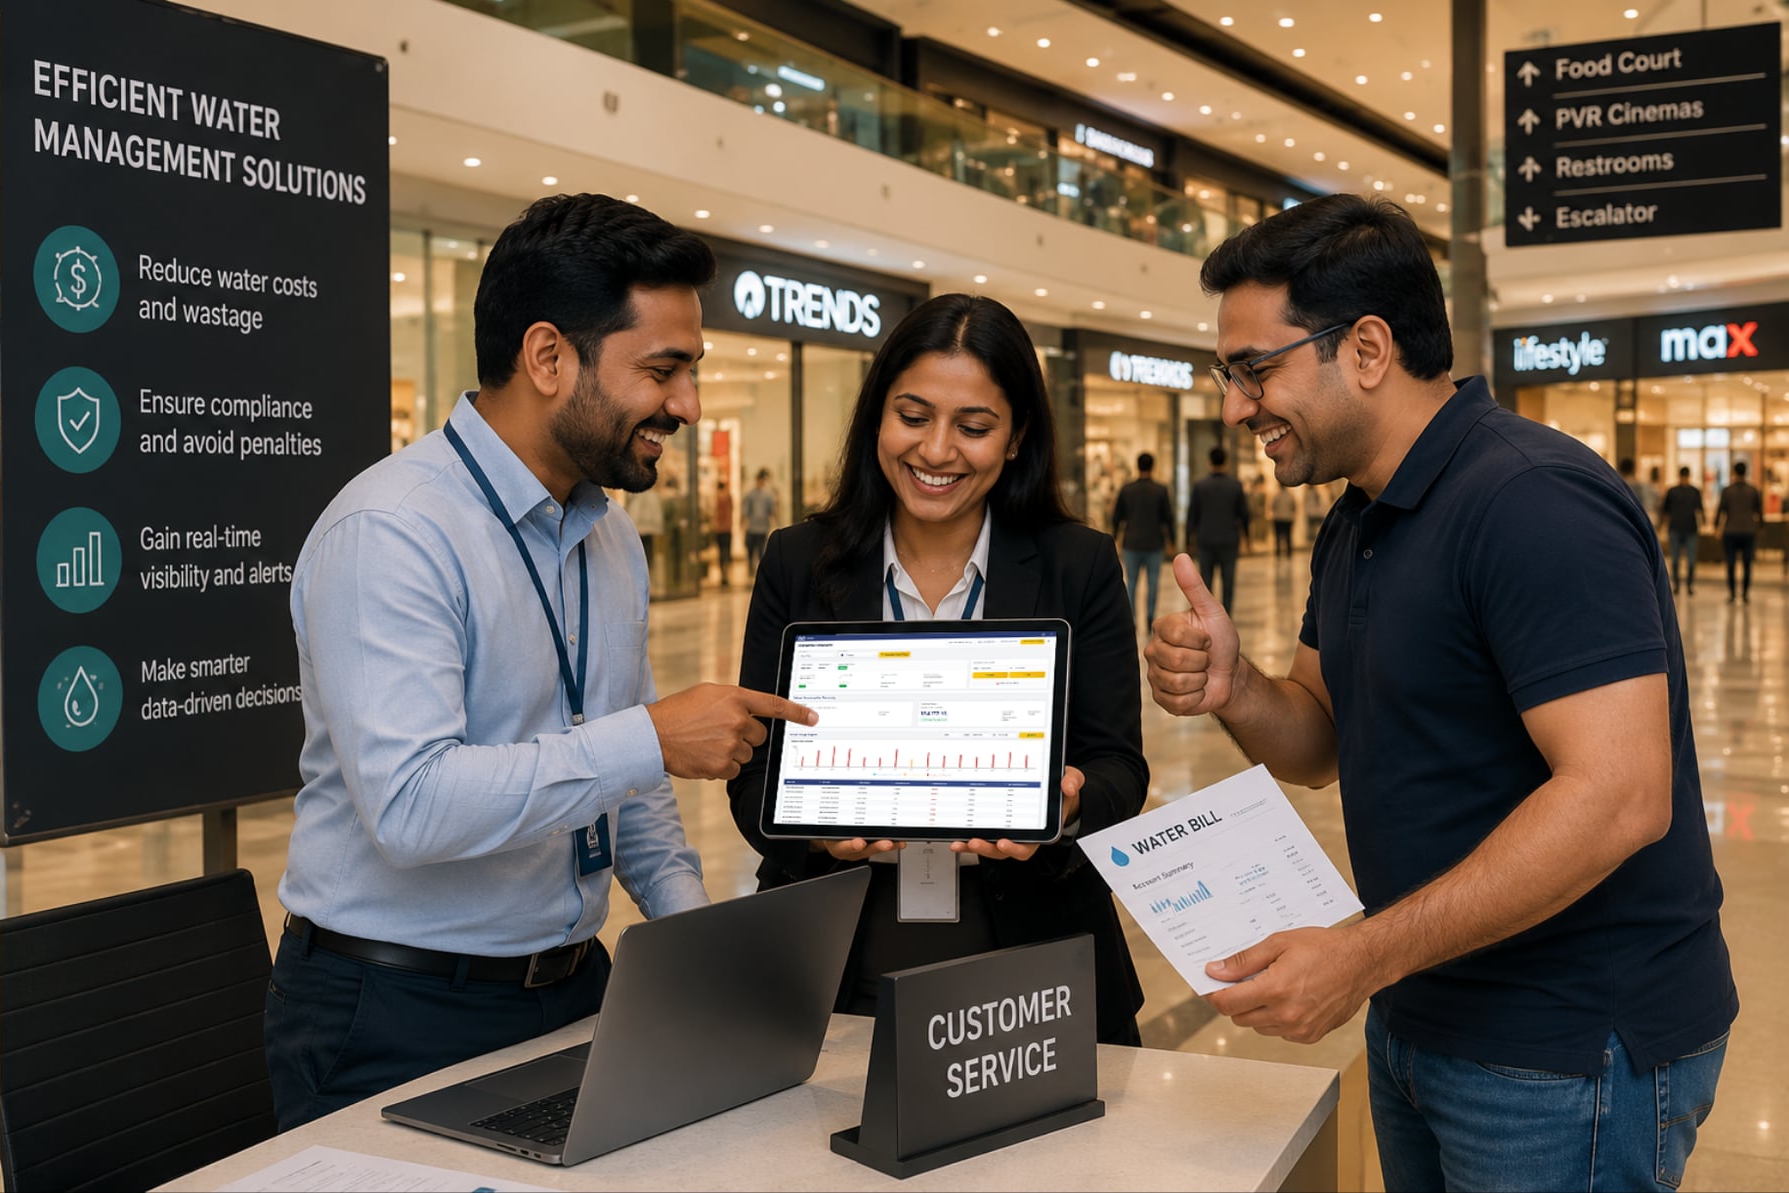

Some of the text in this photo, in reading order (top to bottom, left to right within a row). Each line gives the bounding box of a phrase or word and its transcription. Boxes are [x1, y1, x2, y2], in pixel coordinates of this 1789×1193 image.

[1555, 49, 1682, 79] Food Court
[34, 60, 281, 140] EFFICIENT WATER
[1555, 101, 1704, 128] PVR Cinemas
[34, 118, 366, 204] MANAGEMENT SOLUTIONS
[1556, 153, 1674, 177] Restrooms
[1556, 204, 1658, 228] Escalator
[139, 255, 318, 297] Reduce water costs
[139, 296, 263, 334] and wastage
[764, 276, 881, 337] TRENDS
[1513, 332, 1606, 375] lifestyle
[1660, 322, 1758, 362] max
[140, 389, 313, 422] Ensure compliance
[139, 428, 322, 460] and avoid penalties
[140, 525, 262, 550] Gain real-time
[140, 561, 292, 592] visibility and alerts
[141, 654, 251, 682] Make smarter
[141, 683, 303, 720] data-driven decisions
[1131, 811, 1223, 854] WATER BILL
[928, 985, 1072, 1050] CUSTOMER
[946, 1037, 1057, 1098] SERVICE
